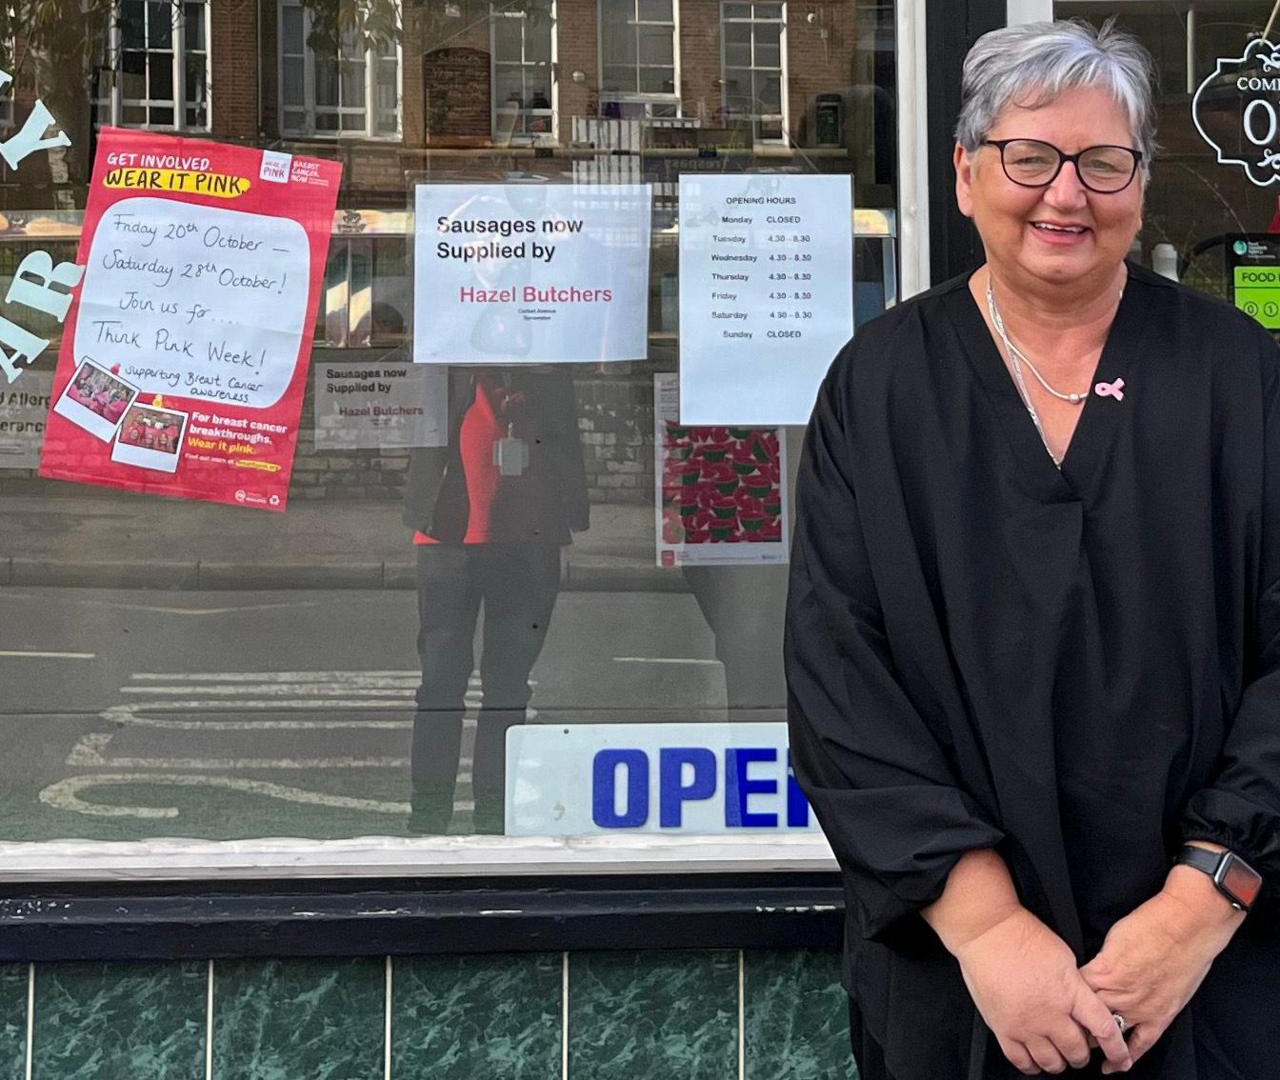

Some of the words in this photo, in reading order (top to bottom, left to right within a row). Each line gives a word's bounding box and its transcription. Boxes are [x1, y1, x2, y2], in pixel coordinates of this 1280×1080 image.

[107, 152, 138, 166] GET
[140, 154, 213, 171] INVOLVED.
[106, 168, 162, 189] WEAR
[169, 172, 190, 189] IT
[263, 166, 285, 178] PINK
[726, 197, 765, 205] OPENING
[766, 197, 797, 205] HOURS
[437, 216, 536, 237] Sausages
[542, 219, 583, 233] now
[722, 216, 753, 225] Monday
[114, 213, 158, 248] Friday
[164, 223, 198, 240] 20th
[204, 225, 264, 252] October
[713, 235, 746, 244] Tuesday
[437, 241, 526, 263] Supplied
[532, 241, 556, 263] by
[711, 254, 758, 263] Wednesday
[103, 248, 174, 288] Saturday
[180, 262, 217, 278] 28th
[712, 273, 749, 281] Thursday
[1242, 272, 1275, 283] FOOD
[460, 285, 516, 302] Hazel
[523, 285, 612, 302] Butchers
[712, 292, 737, 301] Friday
[120, 291, 155, 311] Join
[161, 302, 179, 314] us
[712, 311, 748, 320] Saturday
[92, 320, 141, 349] Think
[155, 328, 194, 358] Pink
[723, 330, 753, 340] Sunday
[767, 330, 801, 338] CLOSED
[326, 368, 380, 380] Sausages
[384, 368, 407, 378] now
[185, 371, 222, 387] Breast
[228, 377, 264, 392] Cancer
[327, 382, 375, 394] Supplied
[378, 382, 391, 394] by
[190, 387, 249, 403] awareness
[339, 406, 370, 416] Hazel
[373, 405, 424, 416] Butchers
[192, 411, 211, 424] For
[212, 414, 248, 429] breast
[250, 421, 288, 434] cancer
[189, 423, 272, 445] breakthroughs.
[188, 437, 216, 450] Wear
[219, 439, 227, 451] it
